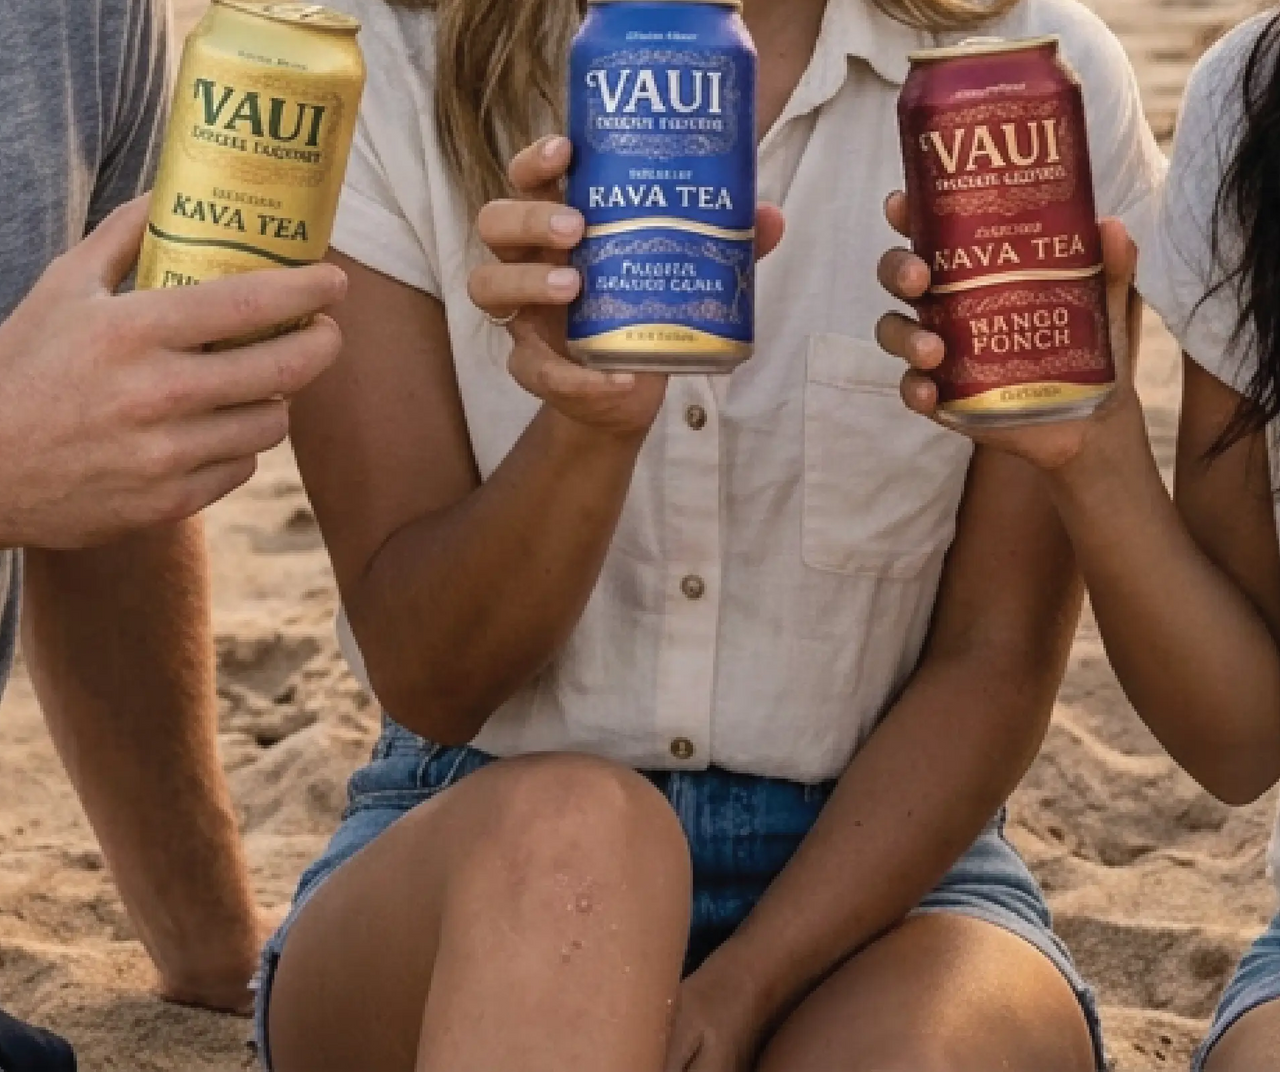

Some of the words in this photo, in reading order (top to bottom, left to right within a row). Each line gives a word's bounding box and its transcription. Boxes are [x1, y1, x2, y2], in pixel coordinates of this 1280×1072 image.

[193, 78, 326, 147] VAUI
[585, 68, 722, 114] VAUI
[919, 119, 1061, 174] VAUI
[171, 192, 246, 233] KAVA
[257, 214, 309, 242] TEA
[589, 184, 668, 209] KAVA
[676, 185, 734, 210] TEA
[933, 241, 1021, 272] KAVA
[1030, 233, 1085, 260] TEA
